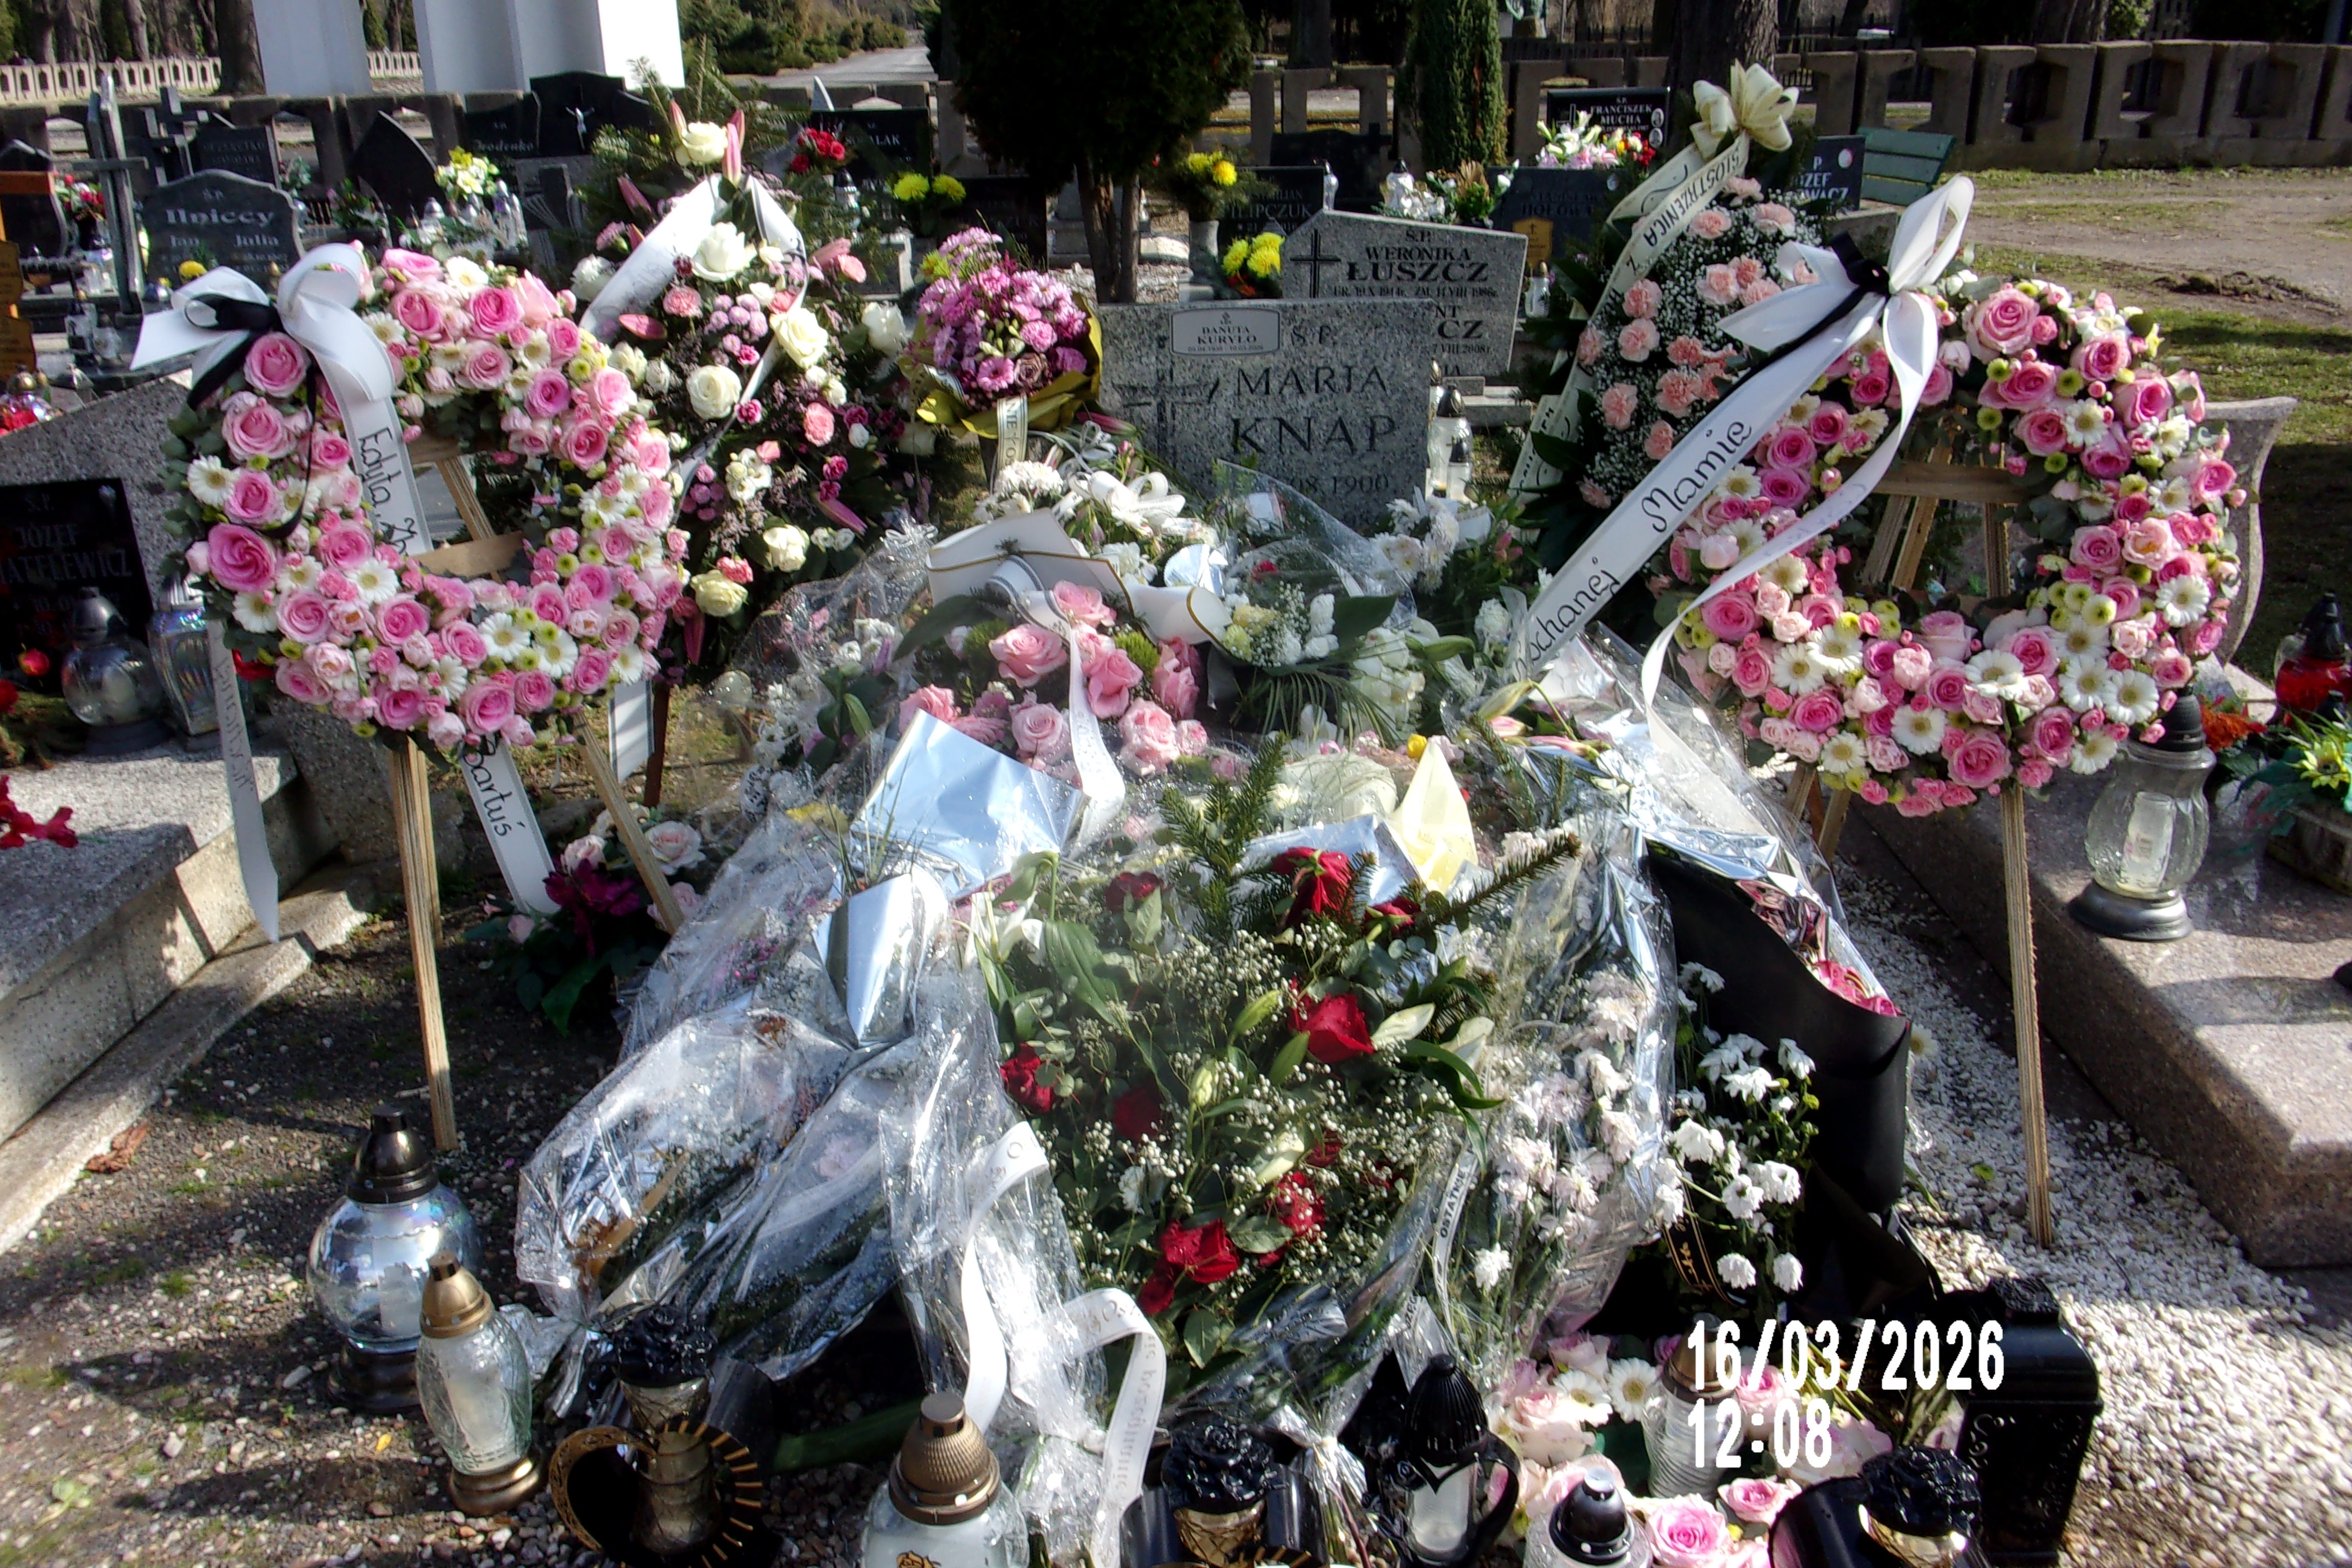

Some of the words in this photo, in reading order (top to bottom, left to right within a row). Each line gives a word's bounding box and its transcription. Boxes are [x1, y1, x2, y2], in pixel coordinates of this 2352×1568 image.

[1590, 104, 1653, 115] FRANCISZEK
[1601, 114, 1641, 126] MUCHA
[234, 233, 280, 248] Julia
[1365, 246, 1471, 261] WERONIKA
[1346, 261, 1489, 282] ŁUSZCZ
[1202, 326, 1250, 334] DANUTA
[1236, 365, 1387, 397] MARIA
[1232, 414, 1399, 455] KNAP
[1641, 419, 1752, 533] Mamie
